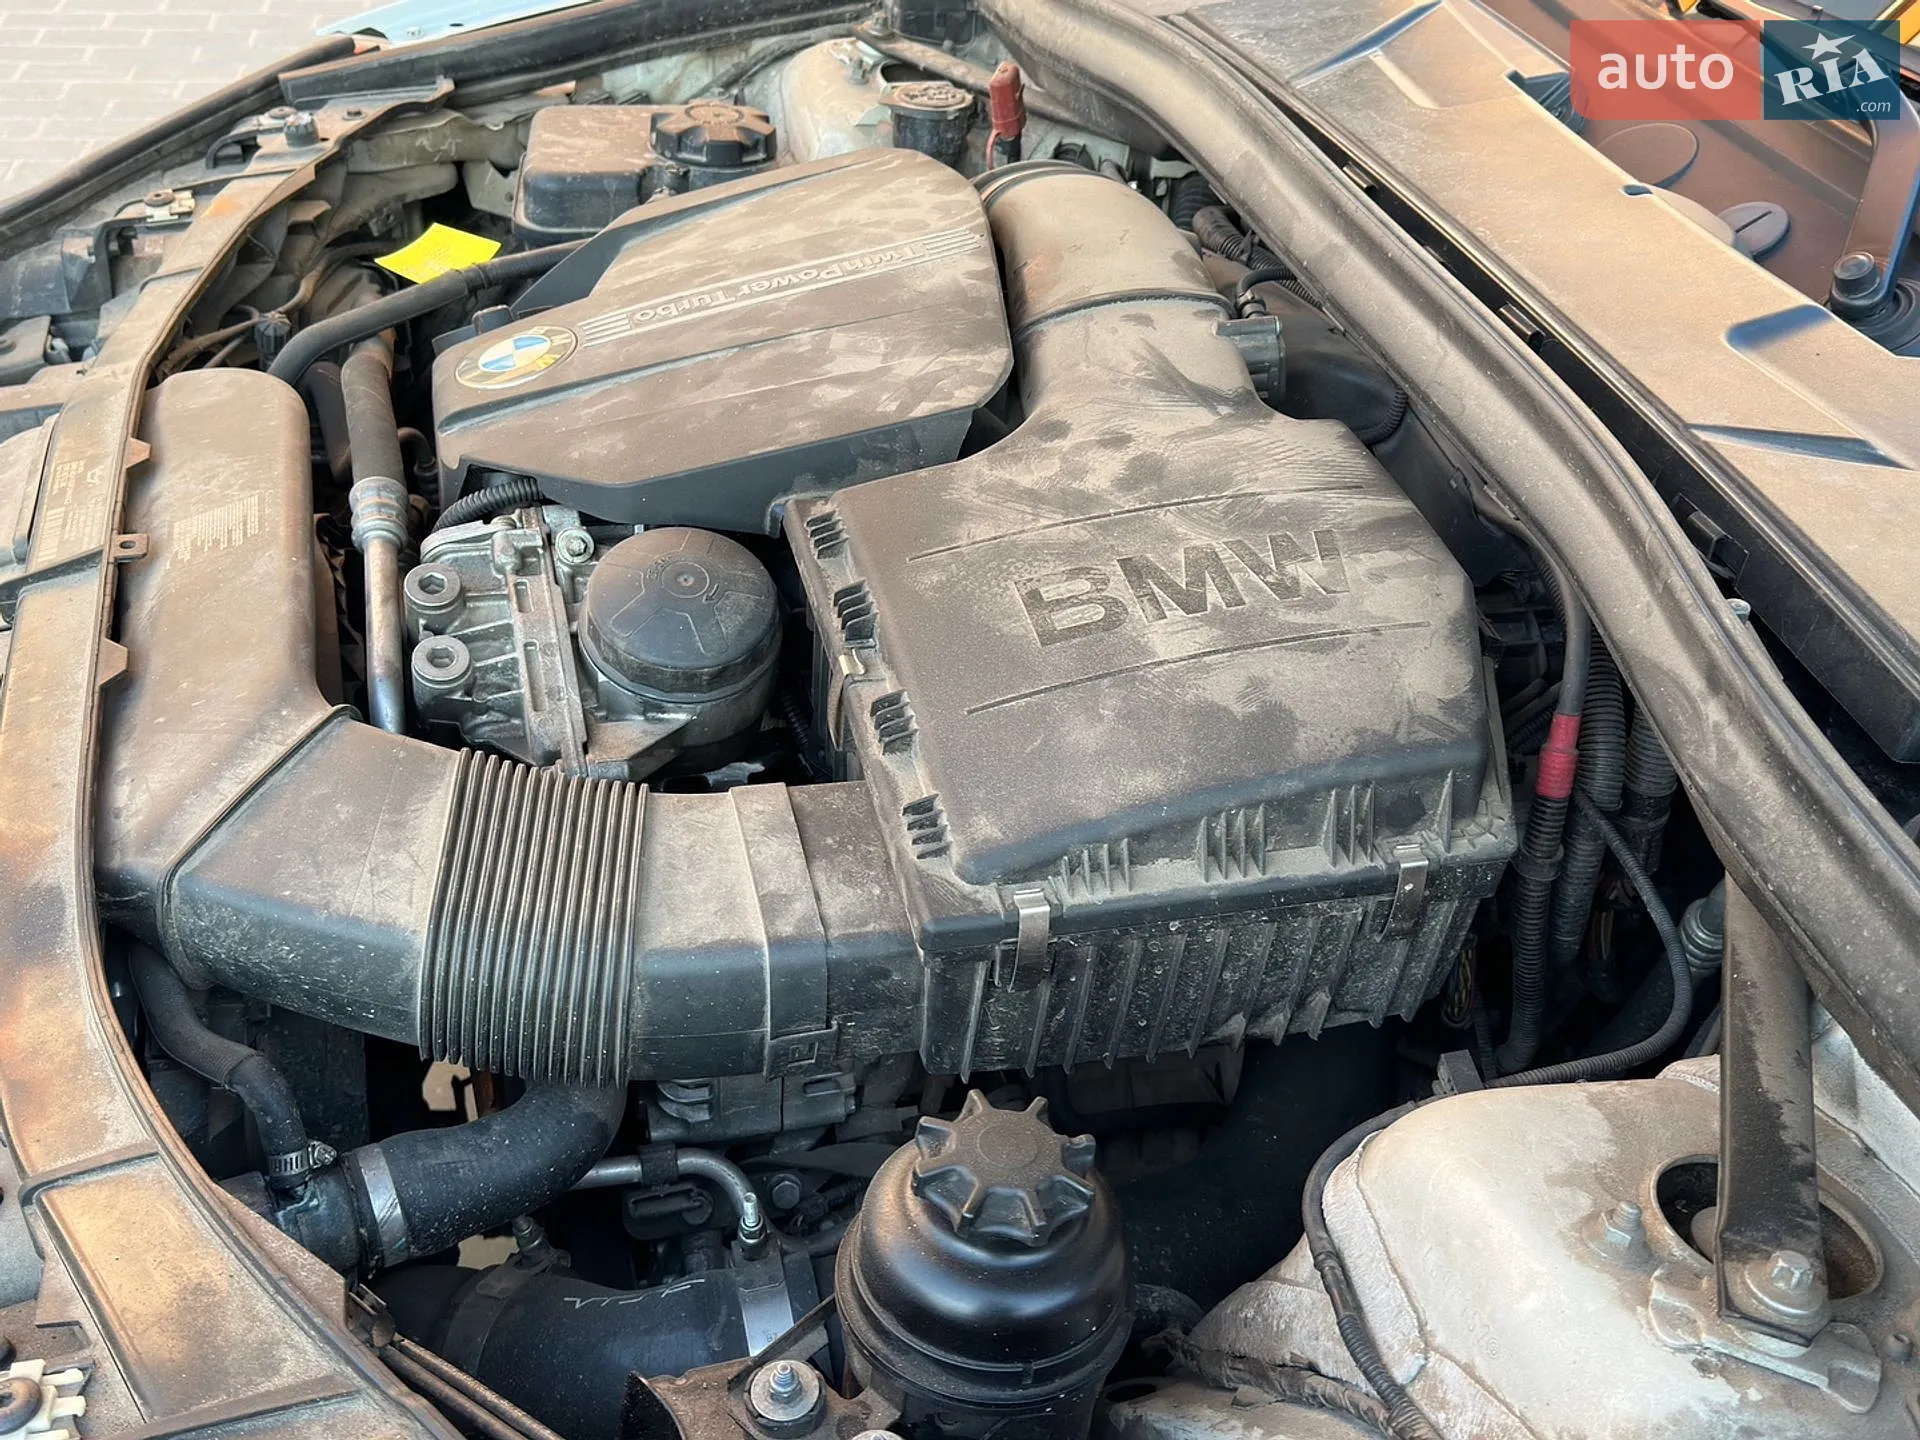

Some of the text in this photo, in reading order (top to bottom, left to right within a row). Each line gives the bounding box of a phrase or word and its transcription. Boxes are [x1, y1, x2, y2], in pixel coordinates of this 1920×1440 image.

[634, 244, 927, 323] TwinPower Turbo
[1014, 528, 1351, 649] BMW
